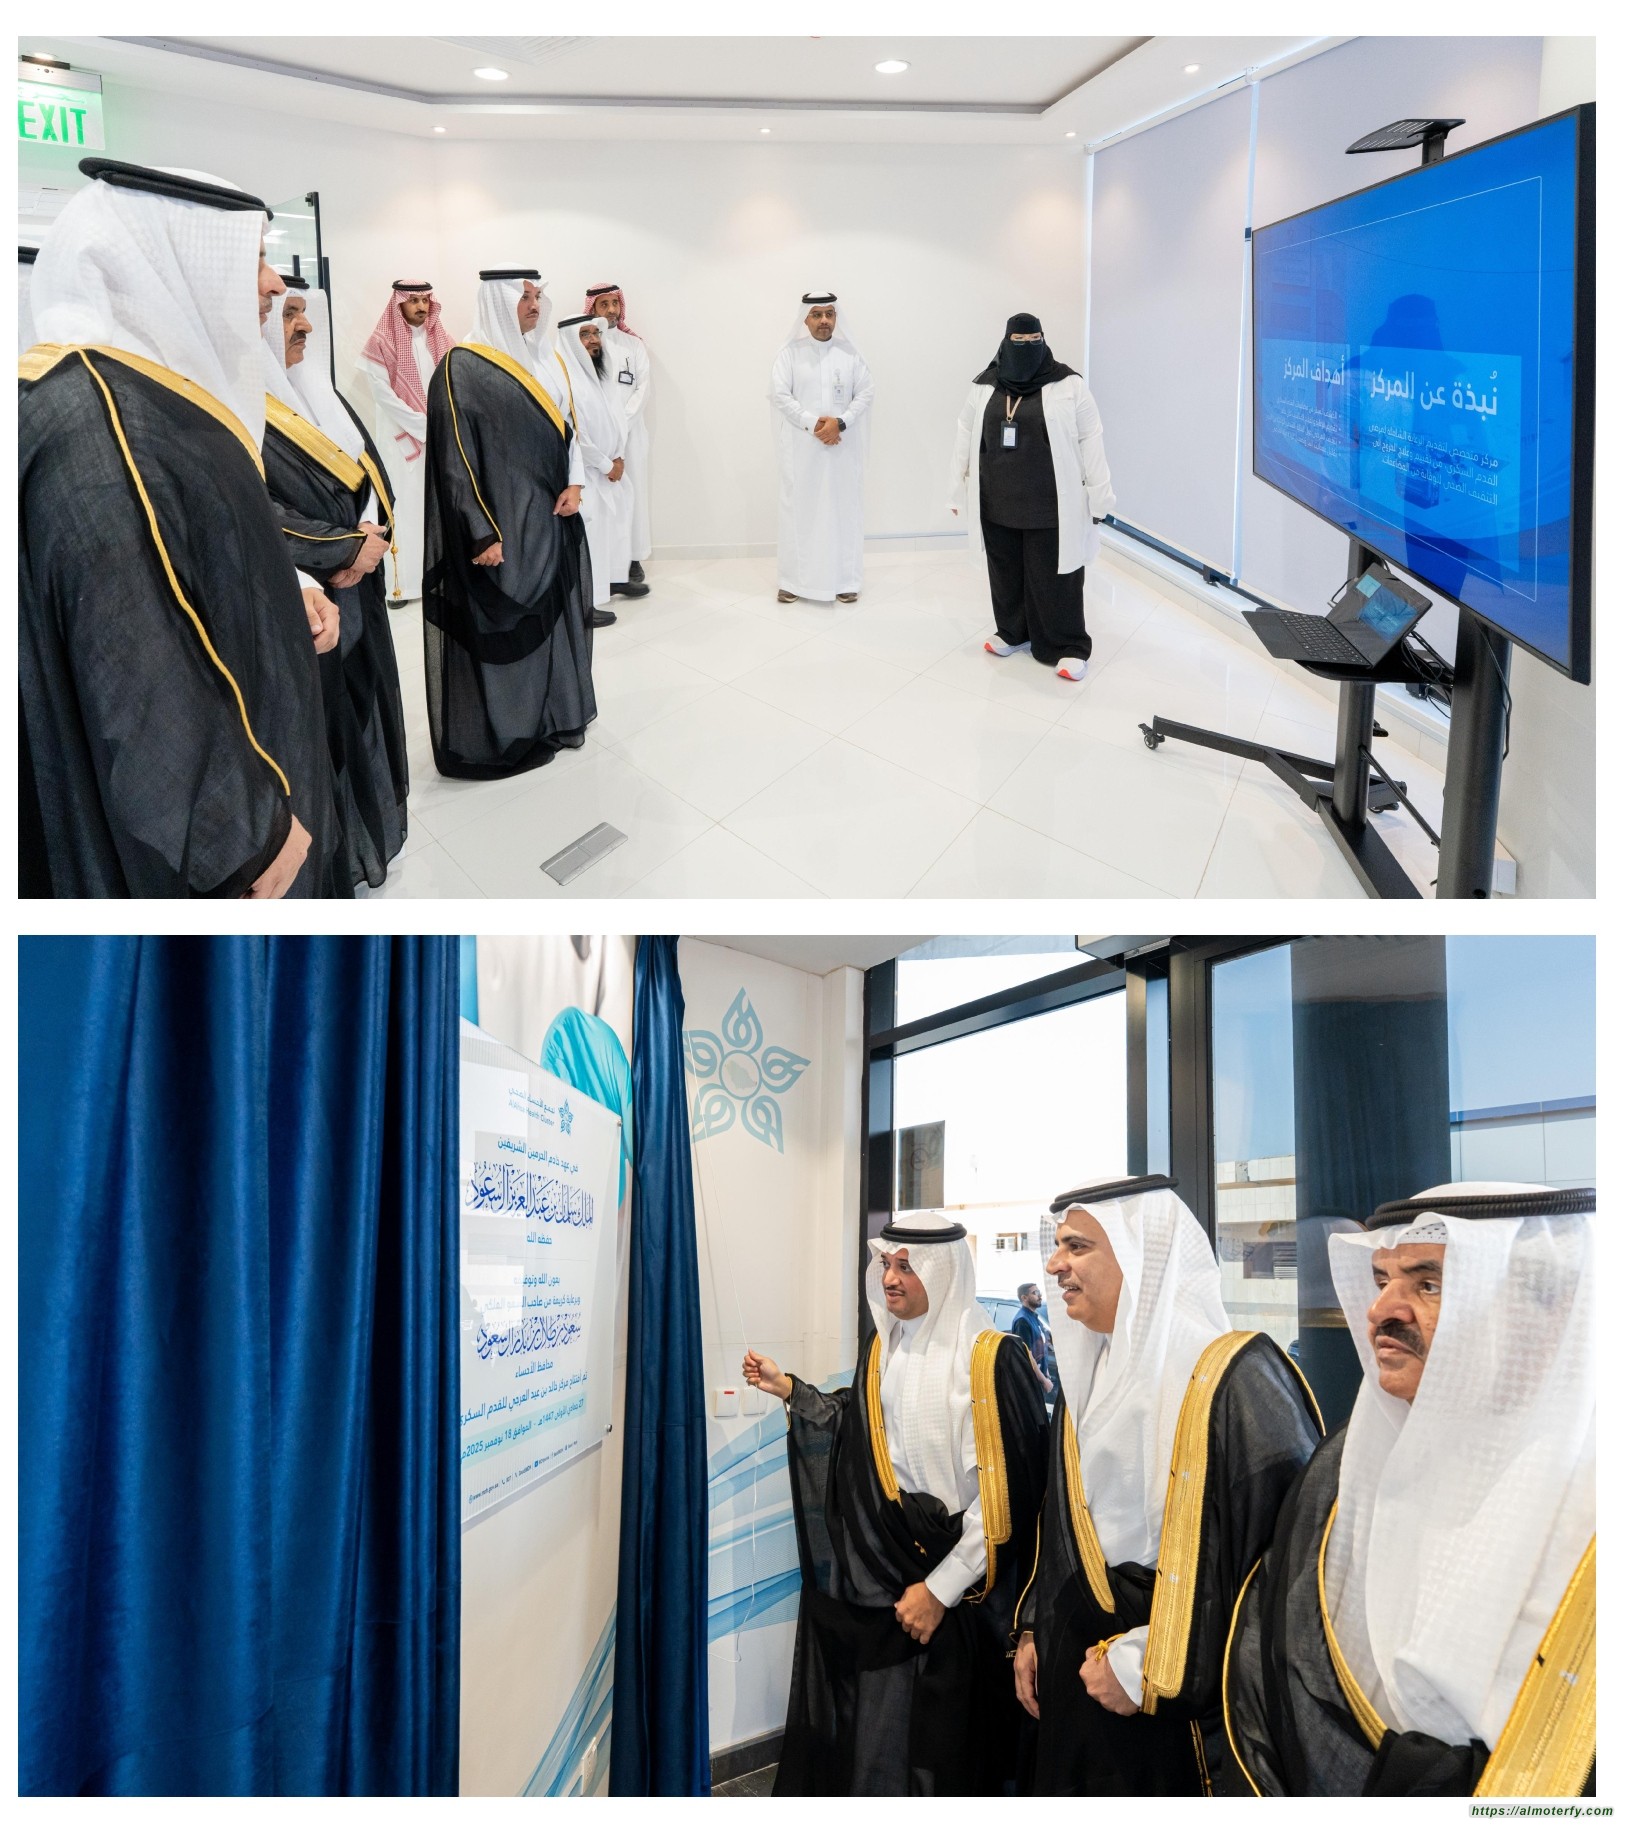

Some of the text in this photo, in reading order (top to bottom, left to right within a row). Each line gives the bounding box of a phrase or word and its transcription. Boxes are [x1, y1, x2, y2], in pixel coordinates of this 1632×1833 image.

[18, 100, 87, 145] EXIT
[1283, 354, 1345, 386] أهداف المركز
[1370, 368, 1415, 402] المركز
[1420, 381, 1446, 411] عن
[1425, 440, 1448, 453] لتقديم
[1449, 448, 1479, 463] متخصص
[1480, 450, 1499, 469] مركز
[1432, 460, 1443, 469] من
[1476, 472, 1498, 487] القدم
[497, 1137, 527, 1154] الشريفين
[528, 1148, 548, 1162] الحرمين
[548, 1154, 560, 1168] خادم
[526, 1232, 553, 1245] حفظه الله
[538, 1273, 548, 1285] الله
[548, 1276, 561, 1287] بعون
[527, 1295, 543, 1310] صاحب
[544, 1298, 552, 1309] من
[515, 1358, 553, 1378] محافظ الأحساء
[548, 1380, 558, 1393] خالد
[558, 1378, 569, 1391] مركز
[540, 1387, 548, 1398] بن
[487, 1396, 508, 1421] للقدم
[579, 1398, 584, 1408] 27
[505, 1428, 512, 1440] 18
[513, 1420, 532, 1440] الموافق
[484, 1433, 504, 1452] نوفمبر
